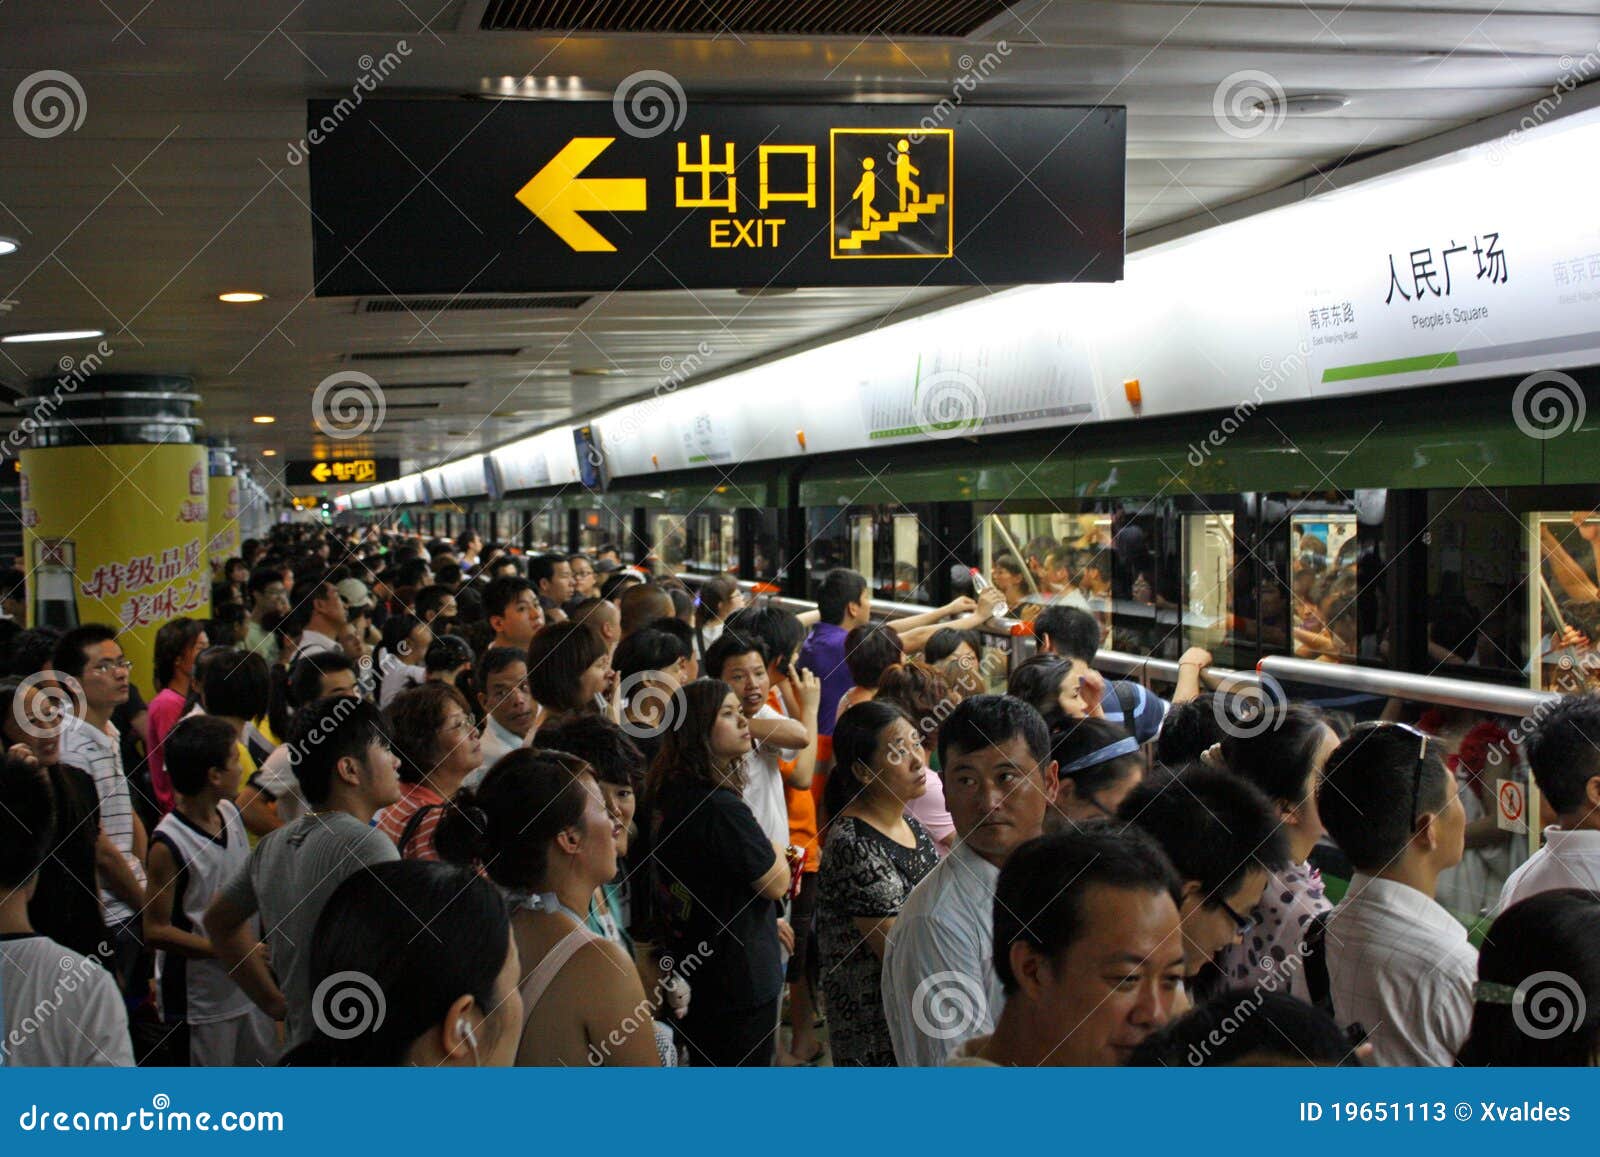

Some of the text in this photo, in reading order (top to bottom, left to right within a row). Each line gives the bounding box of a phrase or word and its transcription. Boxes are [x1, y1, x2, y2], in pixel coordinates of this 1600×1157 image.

[675, 134, 816, 213] 出口
[710, 219, 786, 248] EXIT
[1385, 232, 1509, 304] 人民广场
[1308, 302, 1355, 330] 南京东路
[1411, 304, 1489, 331] People's Square
[81, 539, 200, 598] 特级品质
